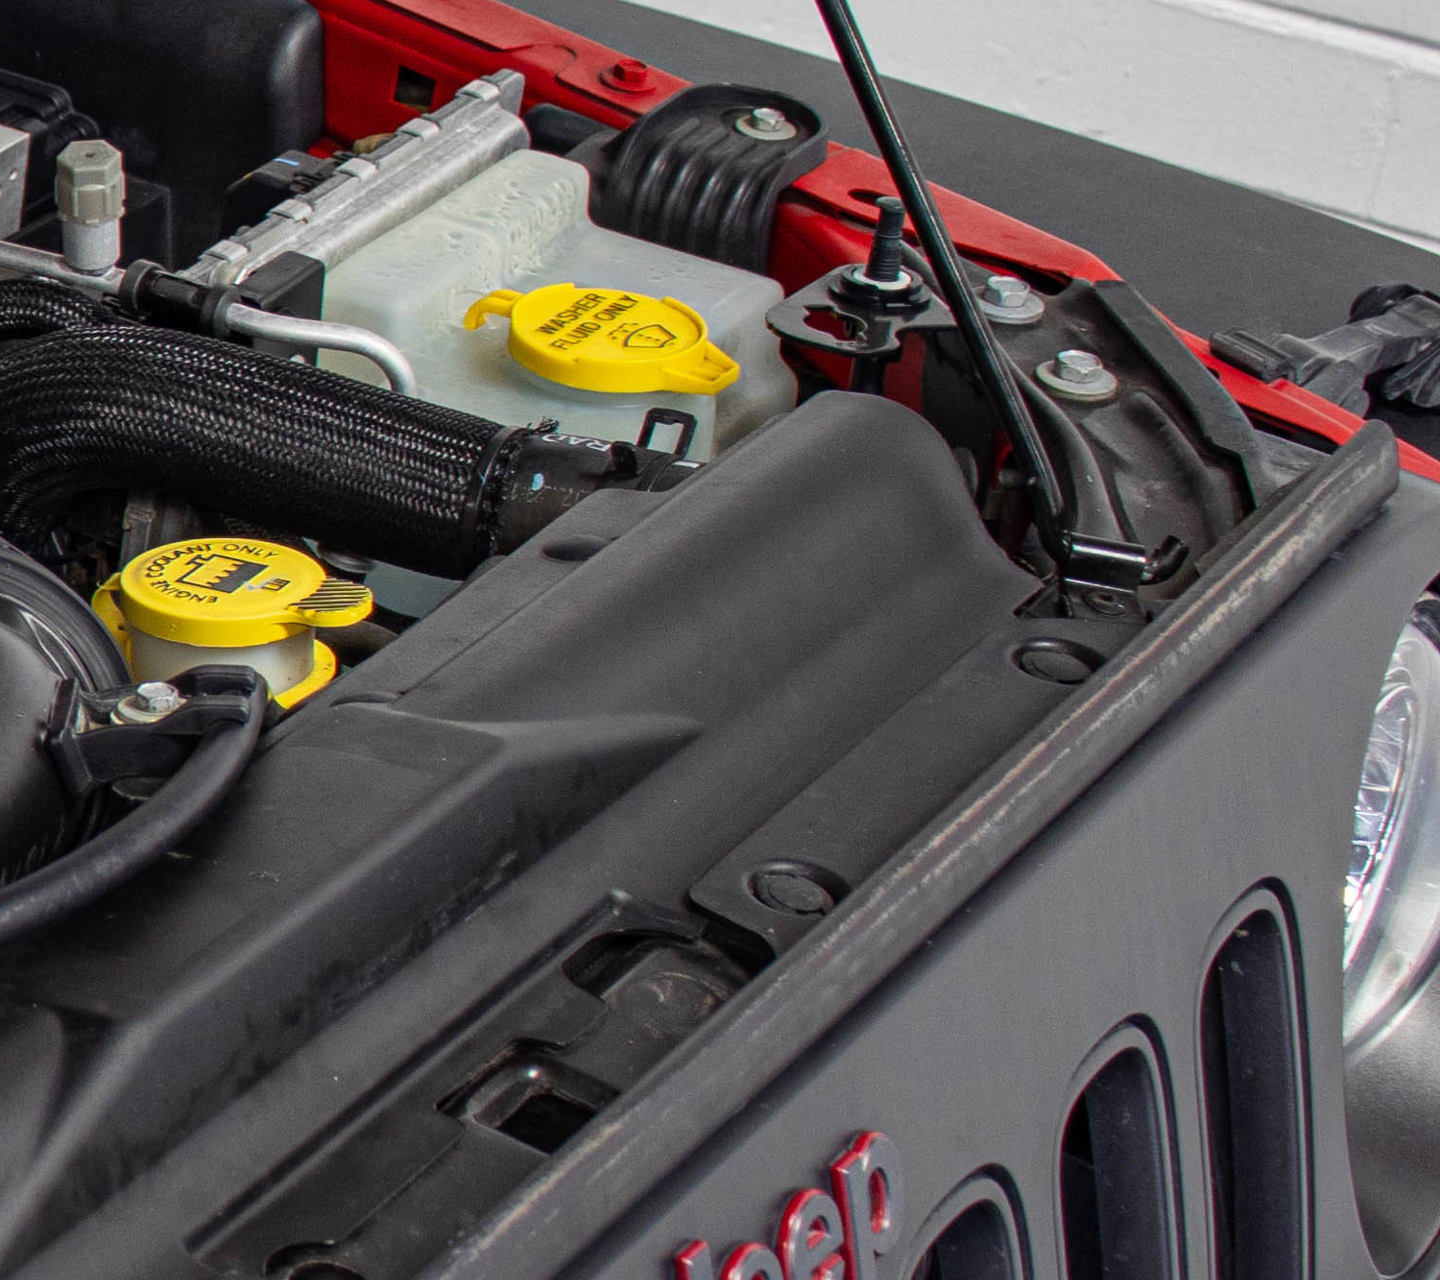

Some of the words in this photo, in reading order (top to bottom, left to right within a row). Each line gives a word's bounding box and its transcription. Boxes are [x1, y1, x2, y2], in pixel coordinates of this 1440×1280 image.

[536, 292, 609, 336] WASHER
[549, 322, 602, 351] FLUID
[594, 294, 641, 322] ONLY
[144, 542, 214, 580] COOLANT
[222, 543, 281, 560] ONLY
[150, 579, 221, 605] ENGINE
